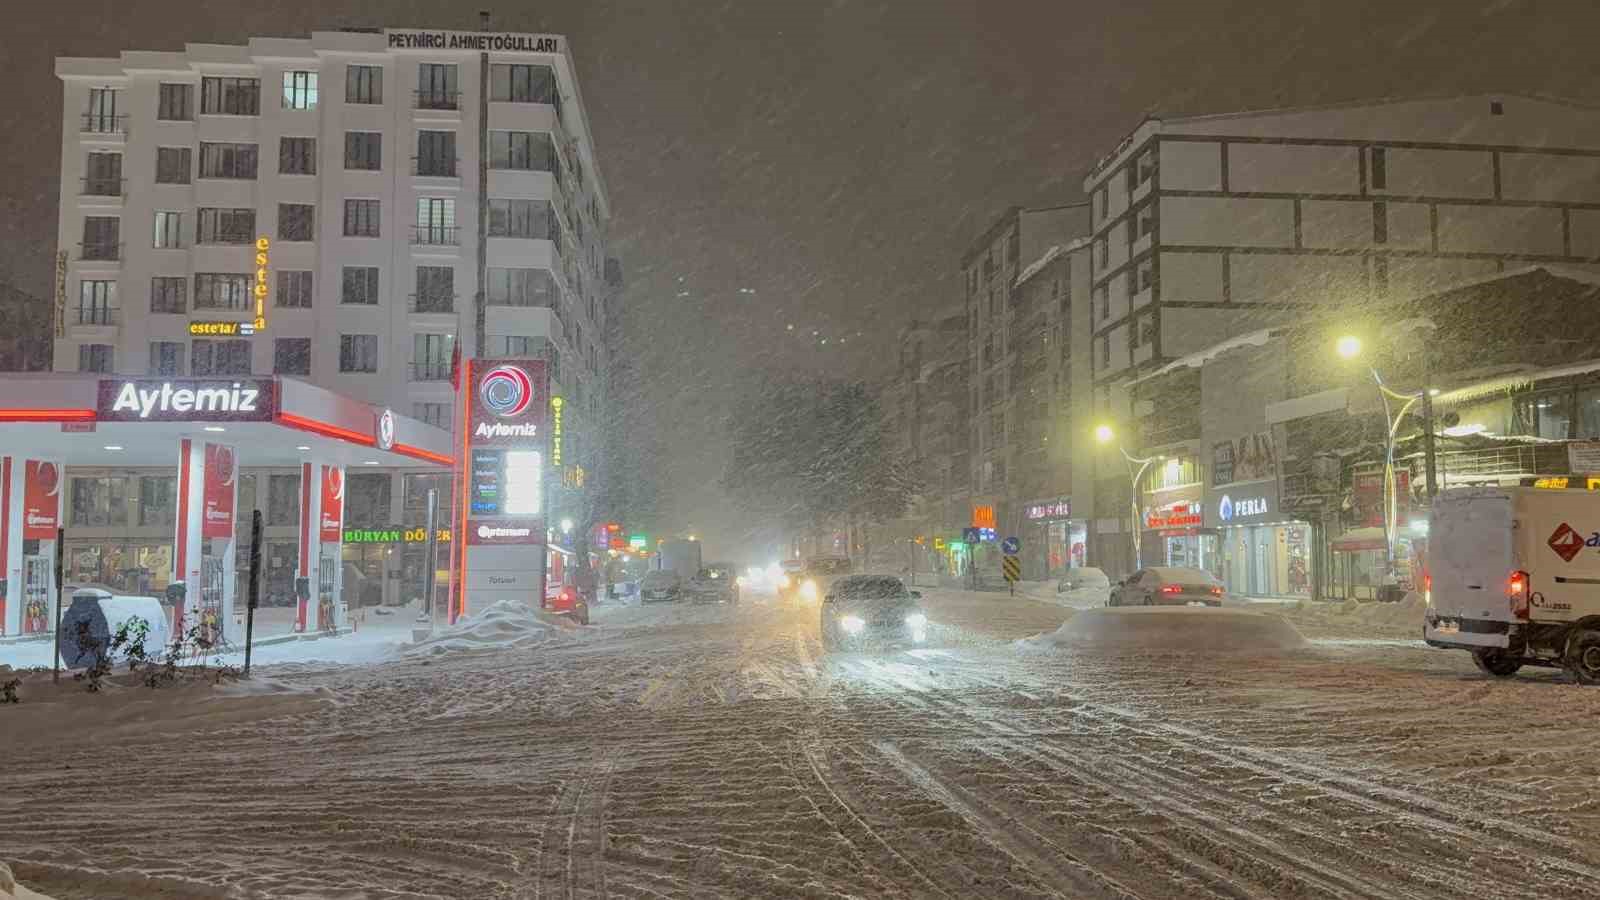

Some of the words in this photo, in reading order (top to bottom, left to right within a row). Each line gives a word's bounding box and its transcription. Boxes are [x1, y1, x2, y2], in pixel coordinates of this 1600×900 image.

[388, 32, 446, 48] PEYNİRCİ
[449, 33, 558, 53] AHMETOĞULLARI
[112, 382, 259, 417] Aytemiz
[476, 422, 537, 437] Aytemiz
[1235, 497, 1268, 516] PERLA
[344, 529, 400, 542] BÜRYAN
